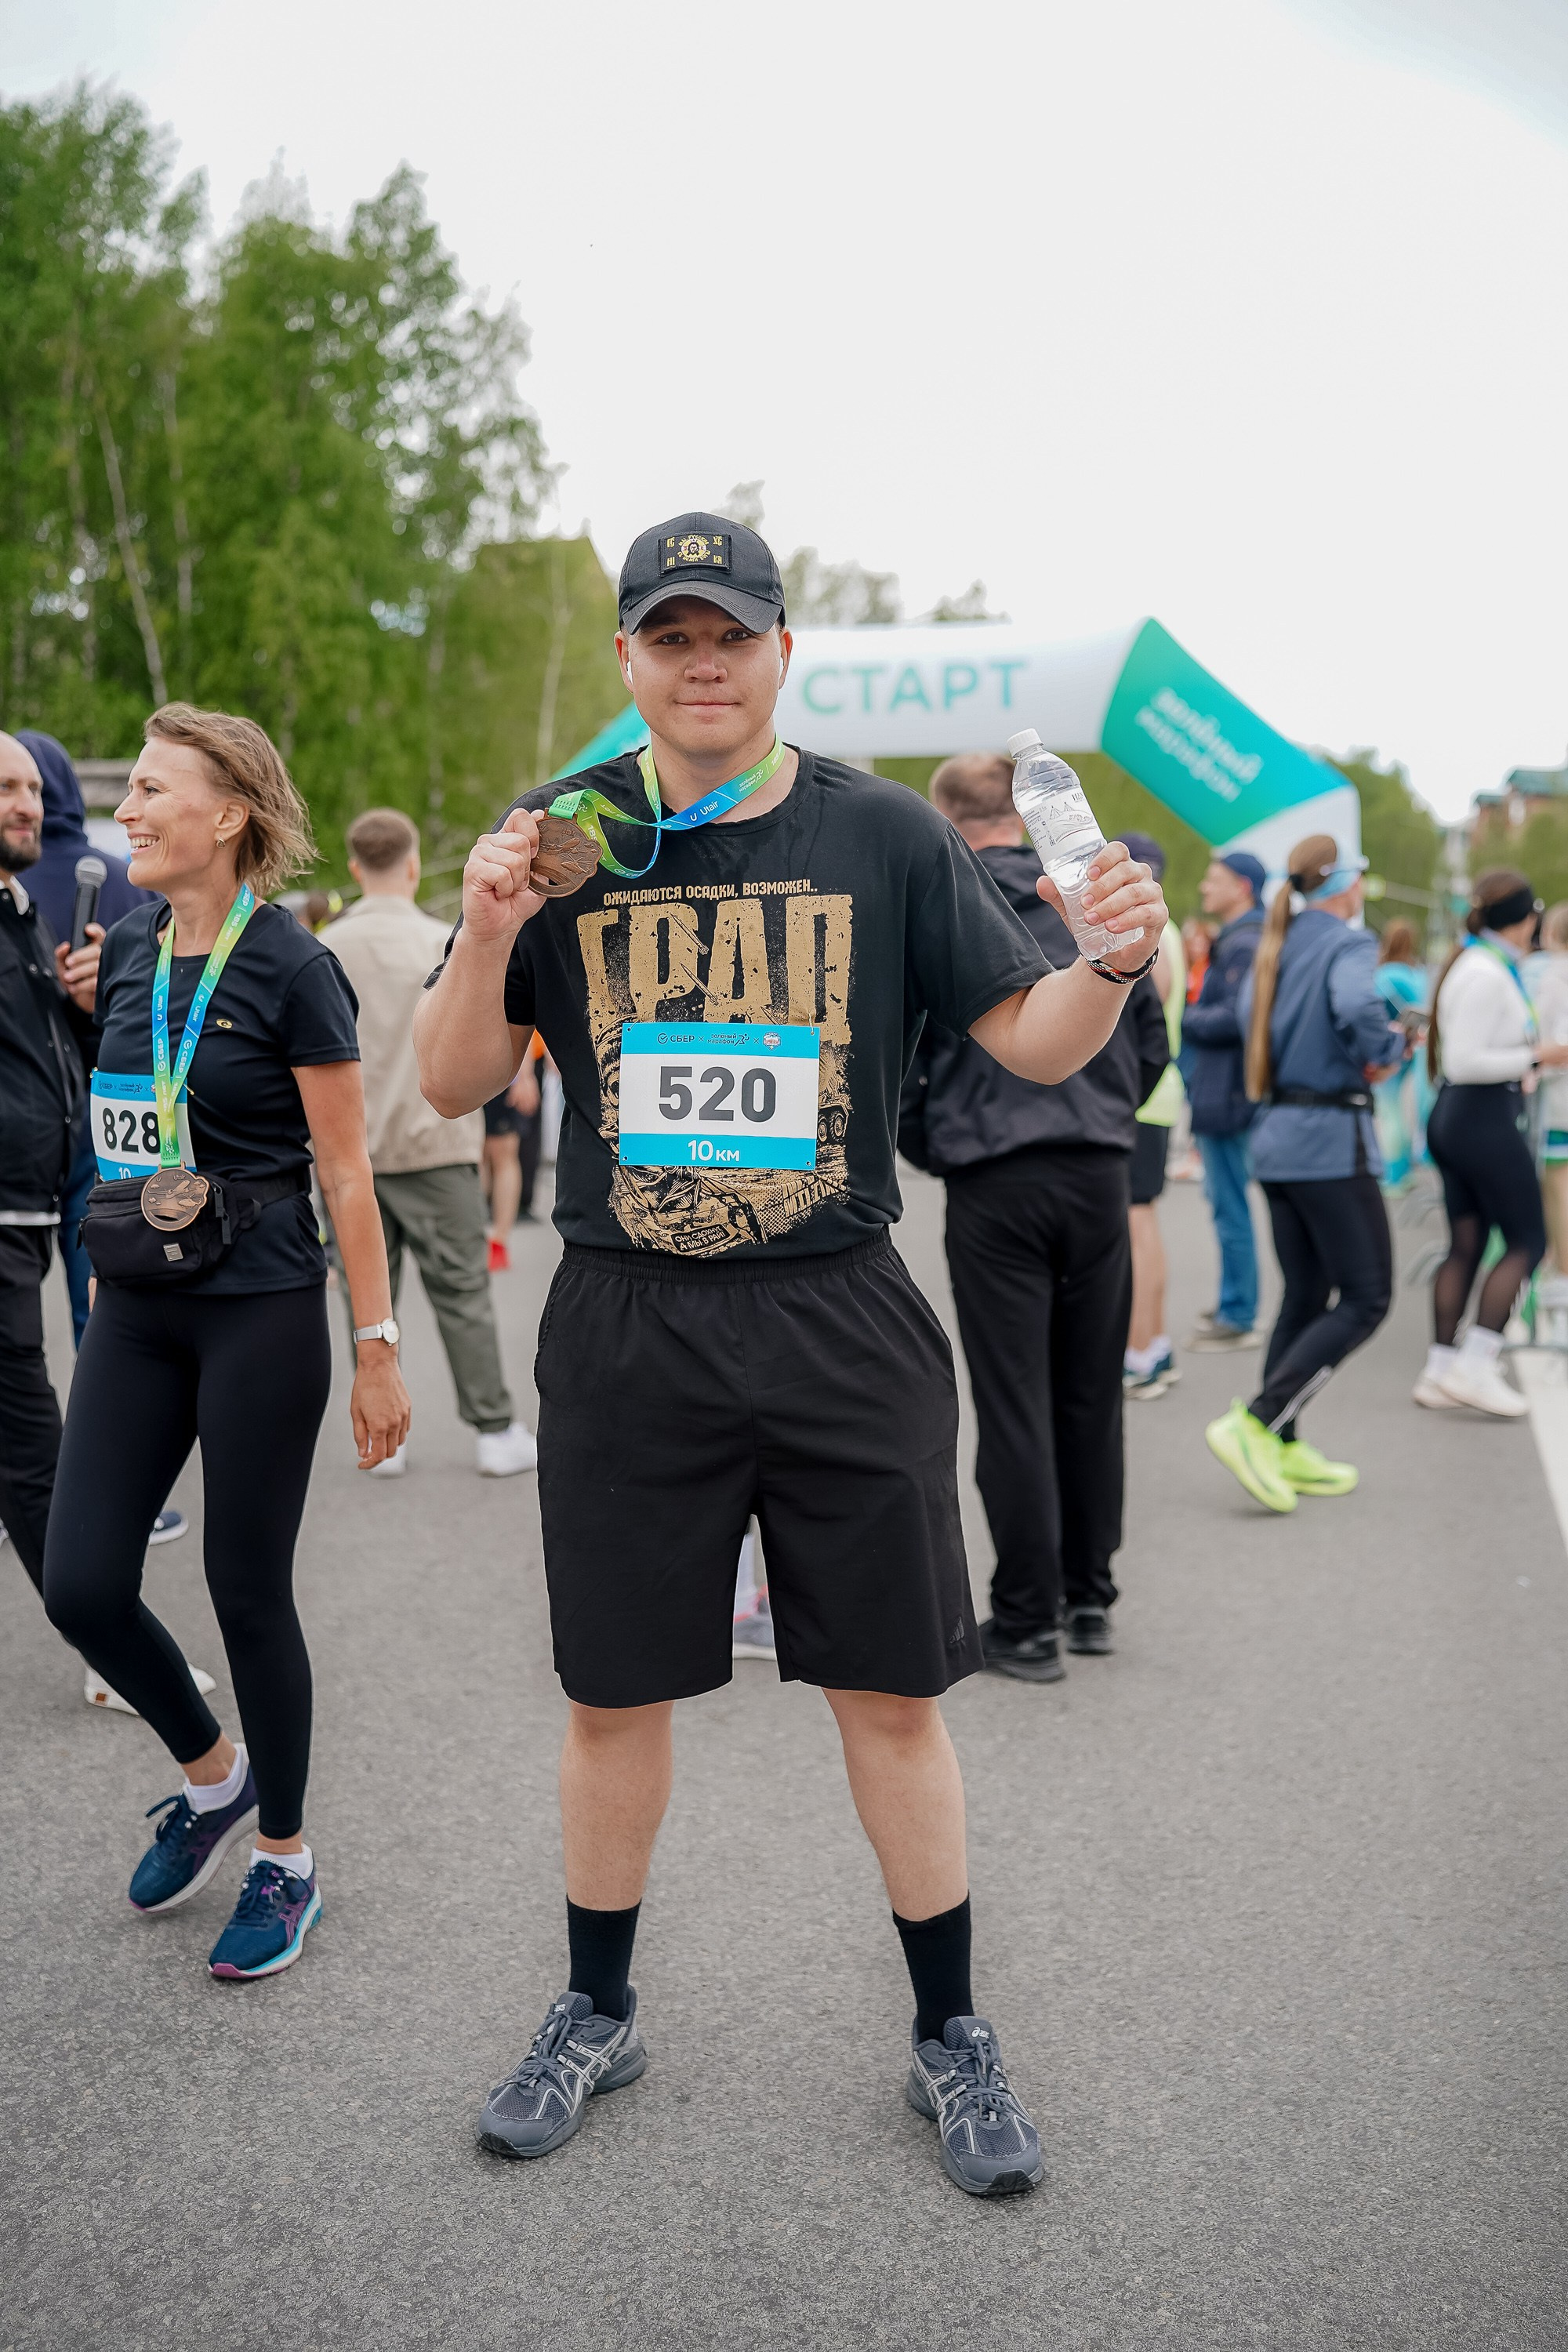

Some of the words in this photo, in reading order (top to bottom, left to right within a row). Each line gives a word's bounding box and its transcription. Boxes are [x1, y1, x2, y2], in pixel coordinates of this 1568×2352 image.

[801, 660, 1025, 716] СТАРТ
[699, 800, 719, 815] Utair
[603, 886, 682, 906] ОЖИДАЮТСЯ
[686, 884, 739, 901] ОСАДКИ,
[742, 878, 818, 896] ВОЗМОЖЕН..
[670, 1035, 695, 1044] СБЕР
[178, 1050, 188, 1074] СБЕР
[659, 1065, 777, 1123] 520
[688, 1139, 714, 1161] 10
[675, 1234, 691, 1243] ОНИ
[680, 1243, 688, 1251] А
[687, 1239, 702, 1249] МЫ
